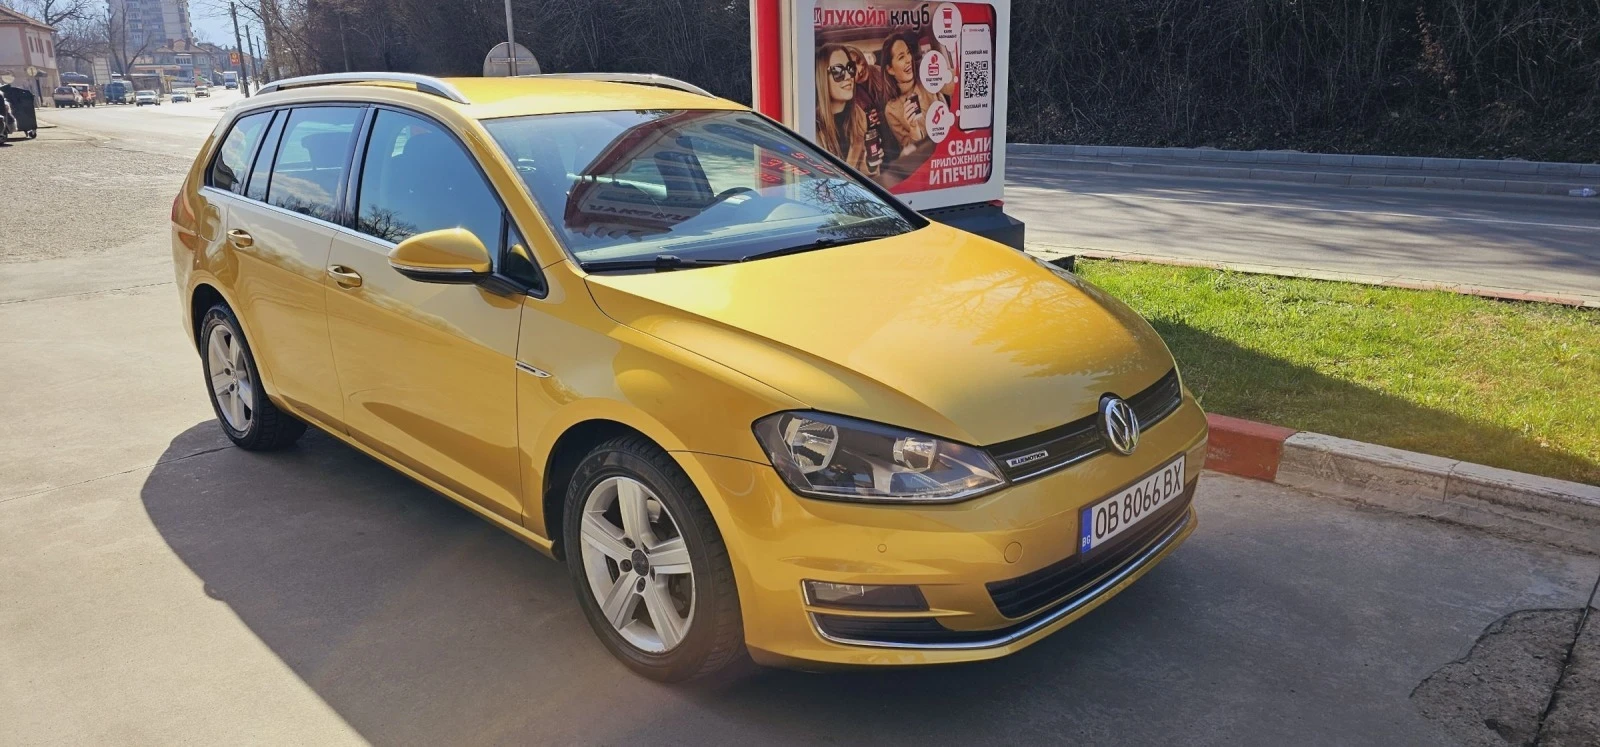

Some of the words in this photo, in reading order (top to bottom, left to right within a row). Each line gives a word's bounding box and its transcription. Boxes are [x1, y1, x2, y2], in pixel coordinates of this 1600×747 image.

[823, 7, 886, 26] ЛУКОЙЛ
[890, 4, 930, 31] клуб
[948, 137, 992, 156] СВАЛИ
[930, 152, 991, 169] ПРИЛОЖЕНИЕТО
[929, 170, 940, 185] И
[943, 163, 991, 183] ПЕЧЕЛИ
[1010, 452, 1046, 466] BLUEMOTION
[1095, 501, 1119, 539] OB
[1122, 476, 1161, 524] 8066
[1163, 461, 1183, 500] BX
[1082, 536, 1091, 547] BG
